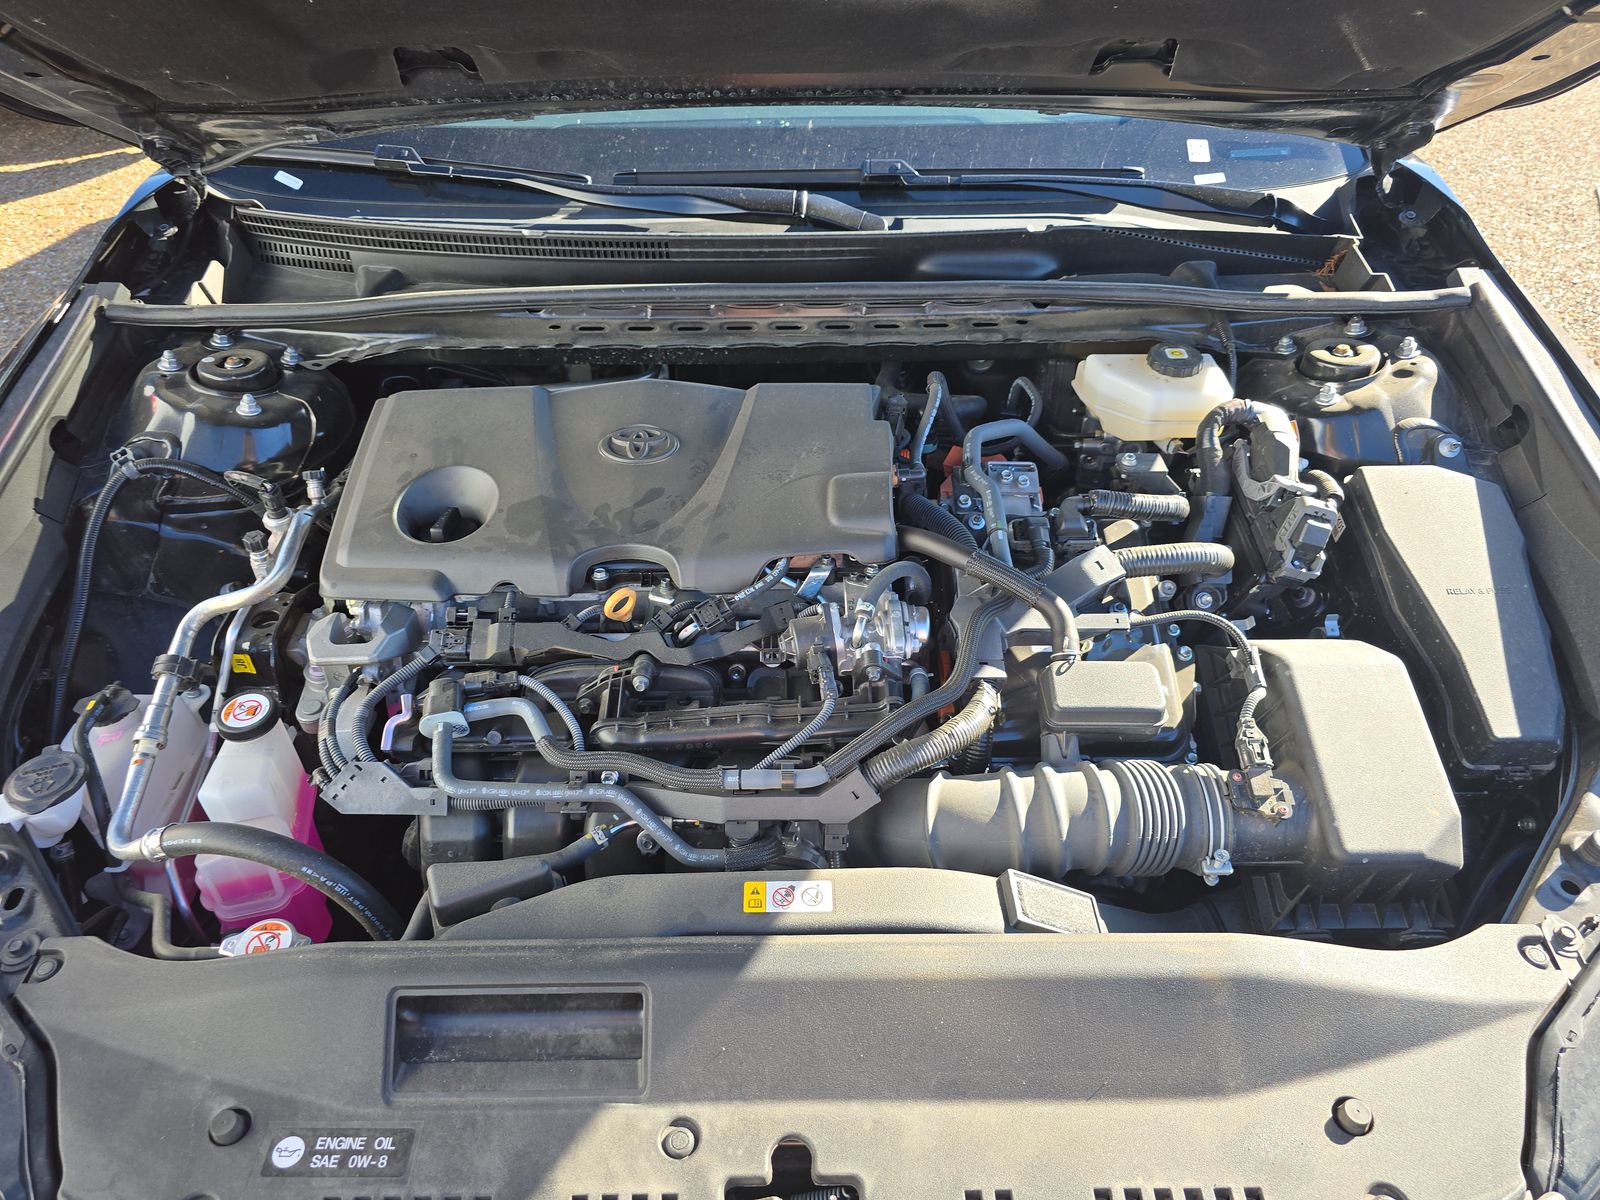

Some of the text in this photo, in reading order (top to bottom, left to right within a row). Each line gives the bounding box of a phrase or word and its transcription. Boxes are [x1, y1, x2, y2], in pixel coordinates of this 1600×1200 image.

[315, 1136, 396, 1150] ENGINE OIL
[310, 1154, 388, 1168] SAE 0W-8
